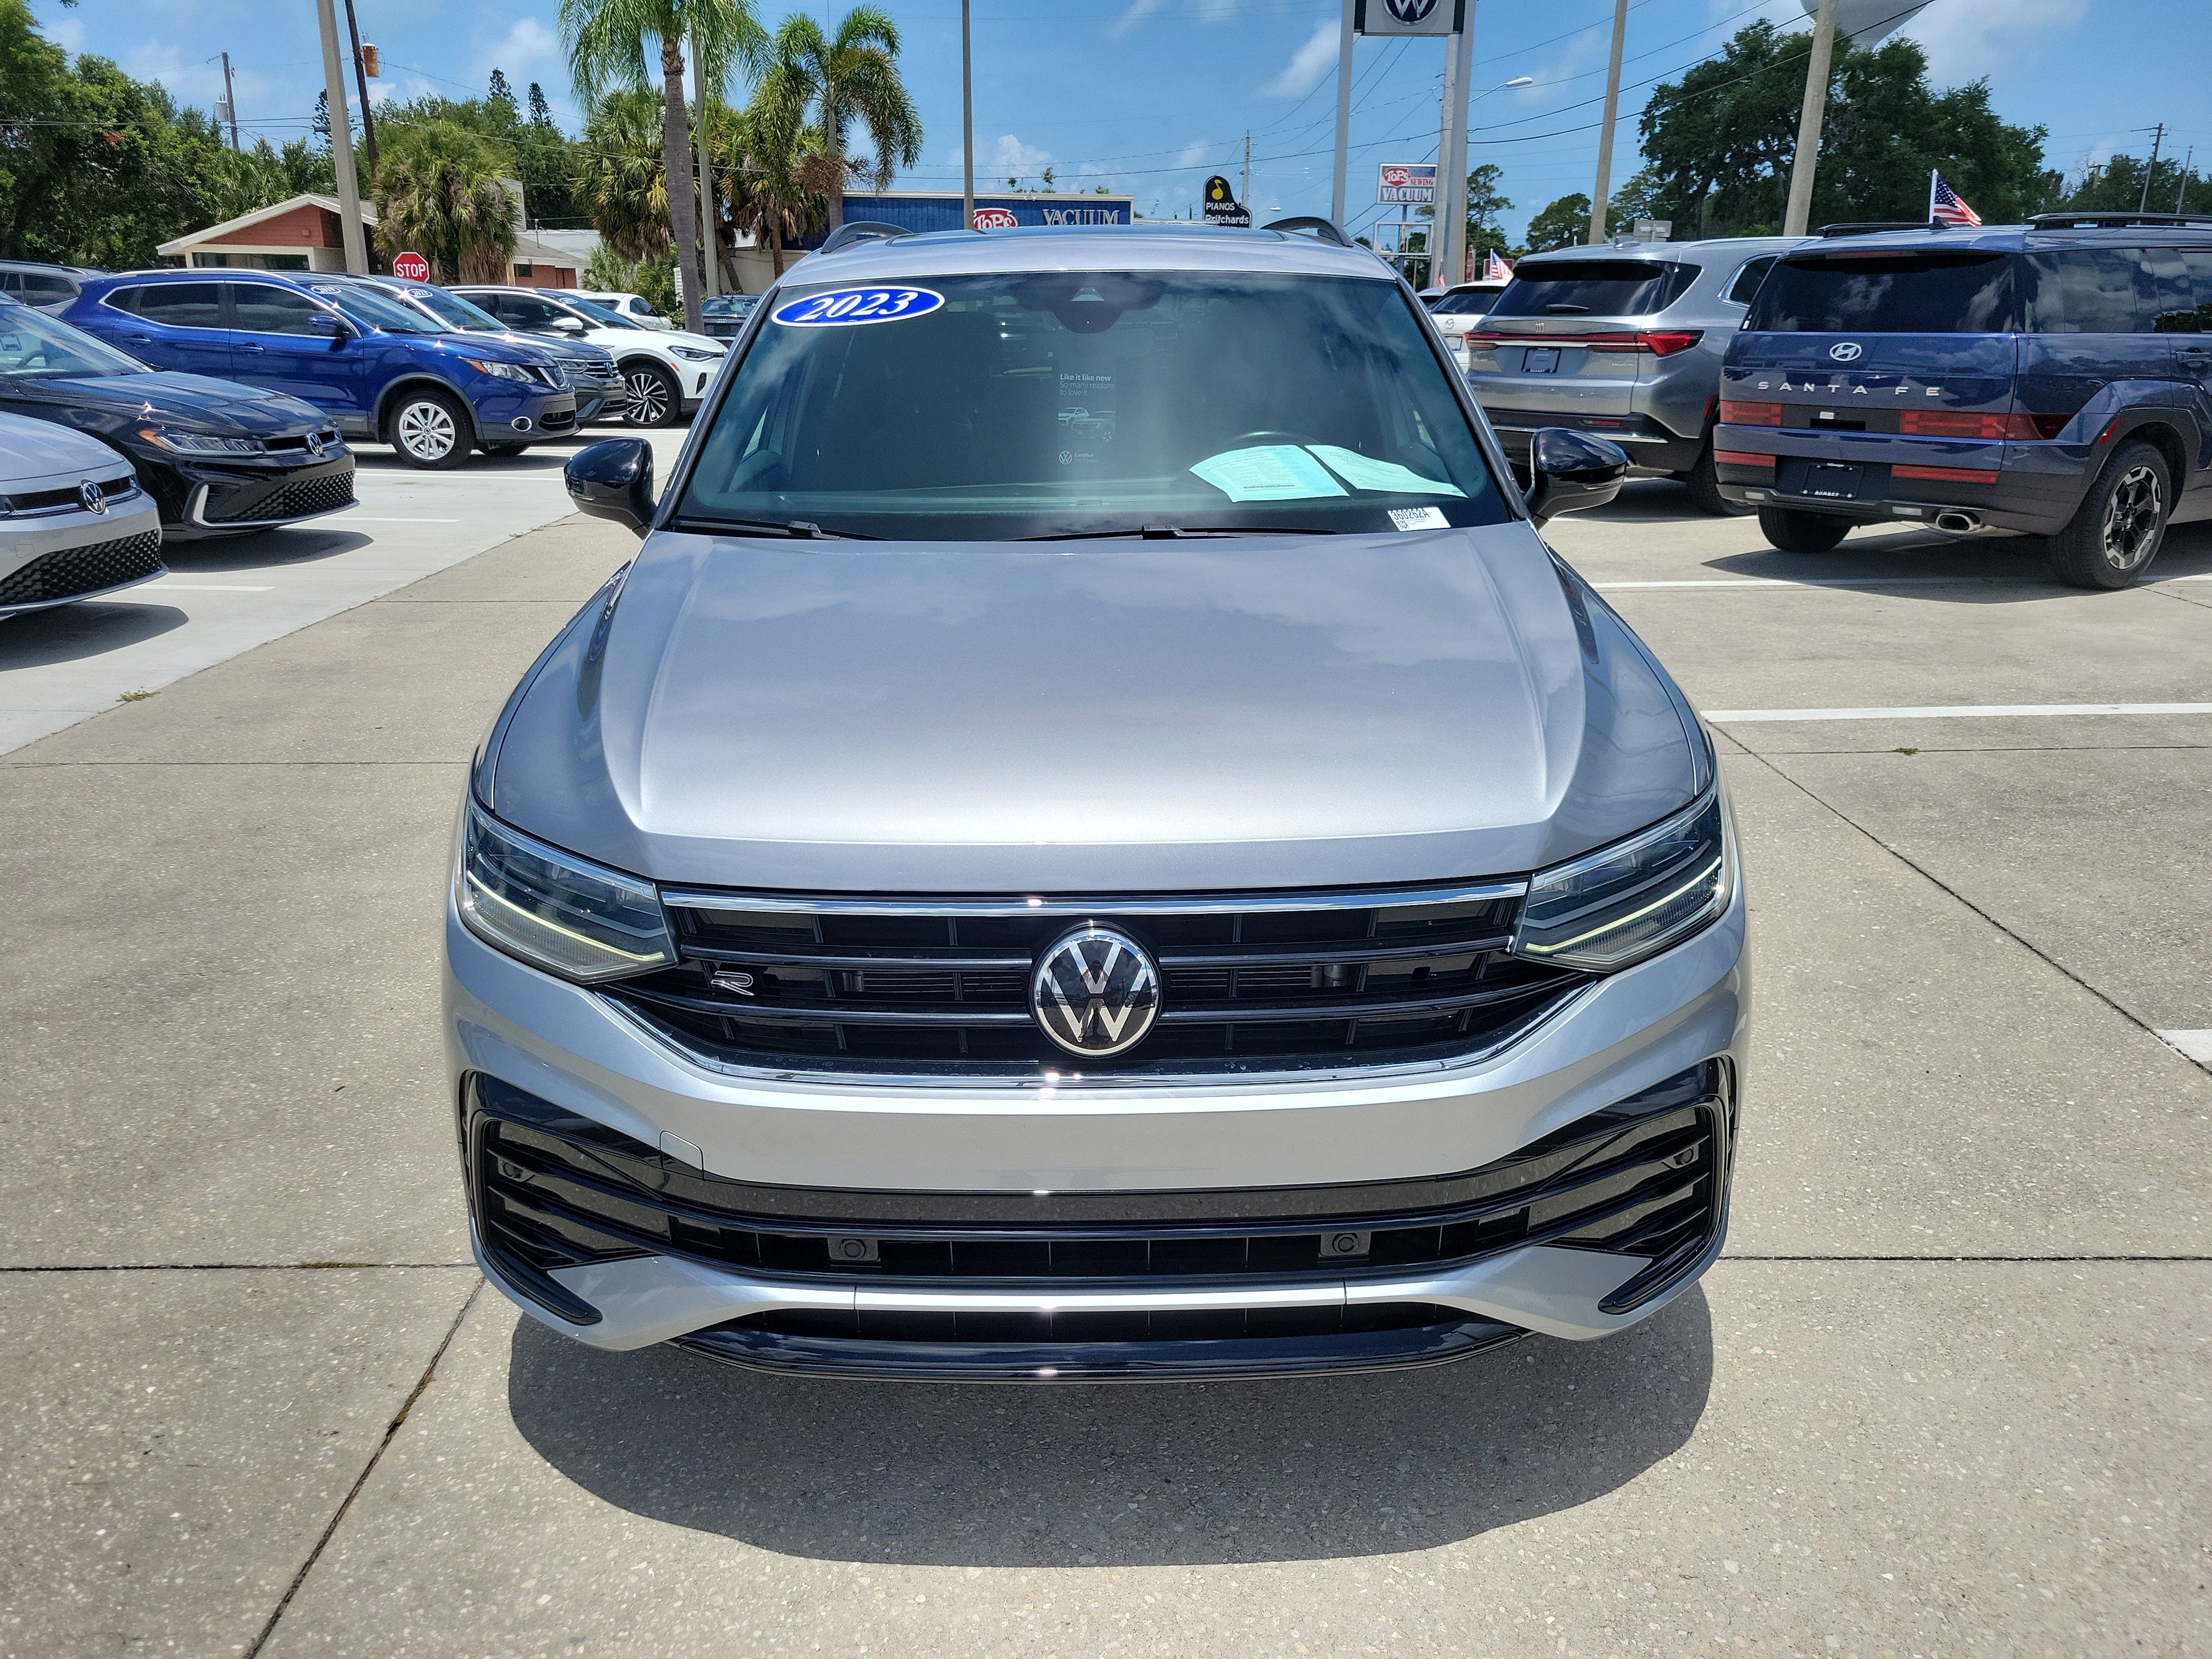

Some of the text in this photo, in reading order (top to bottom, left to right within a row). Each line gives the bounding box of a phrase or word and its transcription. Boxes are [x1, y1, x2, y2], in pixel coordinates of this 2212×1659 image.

[1382, 188, 1433, 201] VACUUM
[1206, 202, 1235, 211] PIANOS
[1042, 209, 1120, 225] VACUUM
[1205, 215, 1249, 224] Pritchards
[397, 263, 426, 277] STOP
[794, 292, 918, 321] 2023
[1758, 381, 1940, 397] SANTA FE
